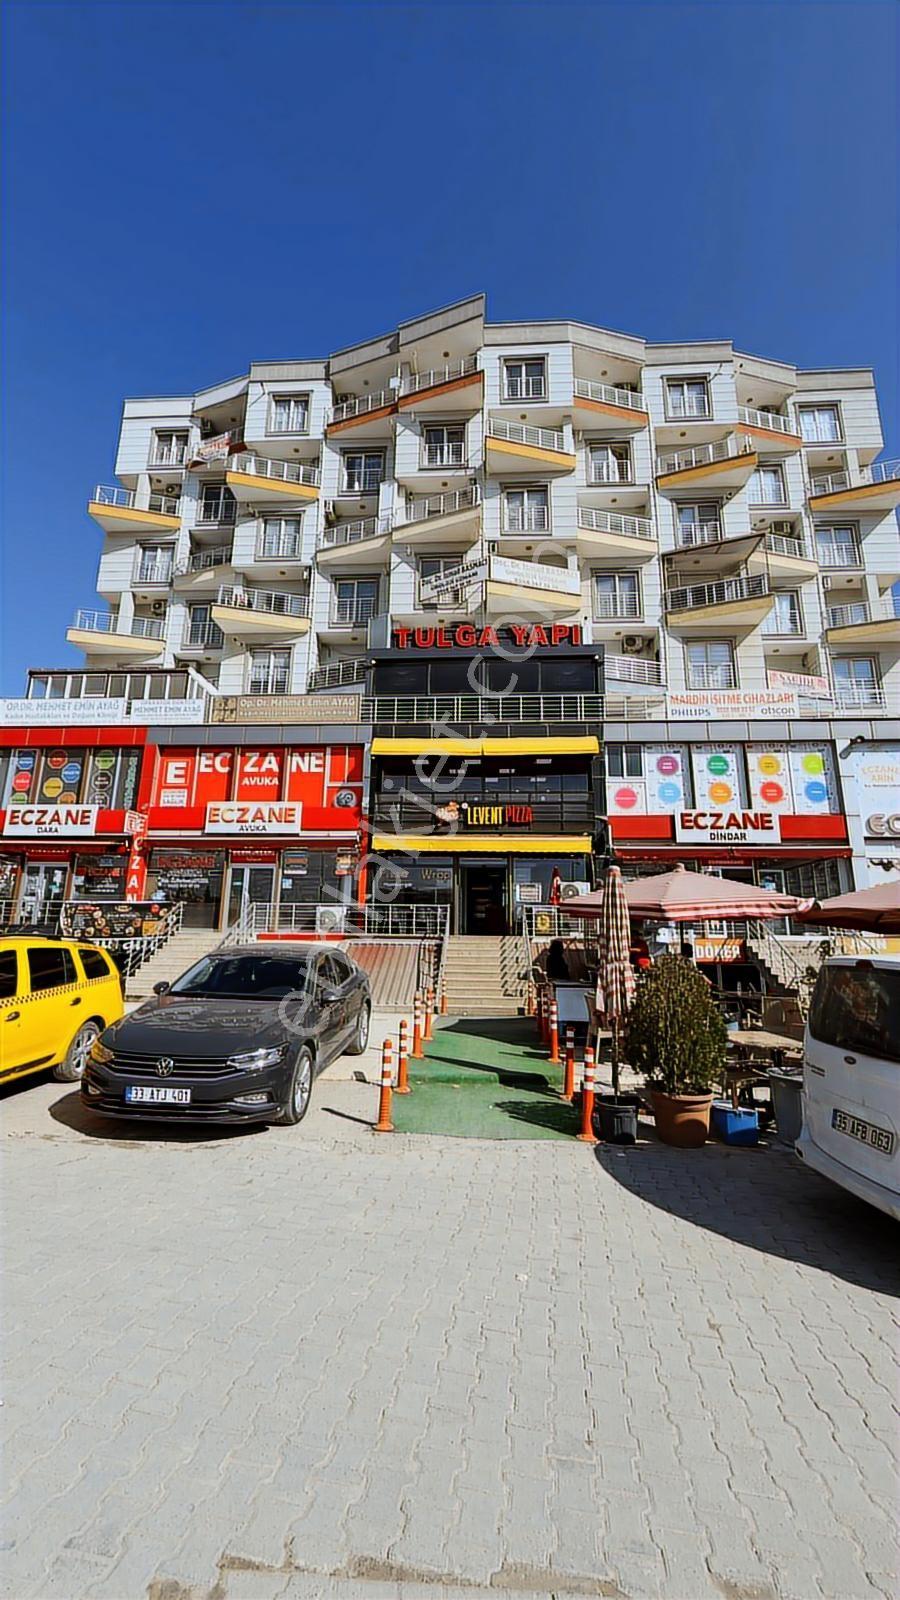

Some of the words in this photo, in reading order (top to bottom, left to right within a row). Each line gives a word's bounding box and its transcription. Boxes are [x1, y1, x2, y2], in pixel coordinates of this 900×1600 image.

[393, 624, 500, 649] TULGA
[512, 624, 581, 647] YAPI
[36, 700, 72, 711] MEHMET
[271, 698, 305, 707] Mehmet
[671, 693, 709, 705] MARDİN
[134, 705, 163, 713] MEHMET
[671, 707, 711, 717] PHILIPS
[166, 762, 187, 784] E
[242, 776, 279, 786] AVUKA
[8, 809, 92, 826] ECZANE
[208, 807, 296, 823] ECZANE
[467, 806, 504, 825] LEVENT
[680, 812, 774, 831] ECZANE
[709, 831, 748, 841] DİNDAR
[421, 867, 452, 881] Wrap
[133, 1087, 144, 1100] 33
[149, 1088, 168, 1101] ATJ
[171, 1090, 189, 1102] 401
[836, 1112, 849, 1131] 35
[870, 1129, 891, 1151] 063
